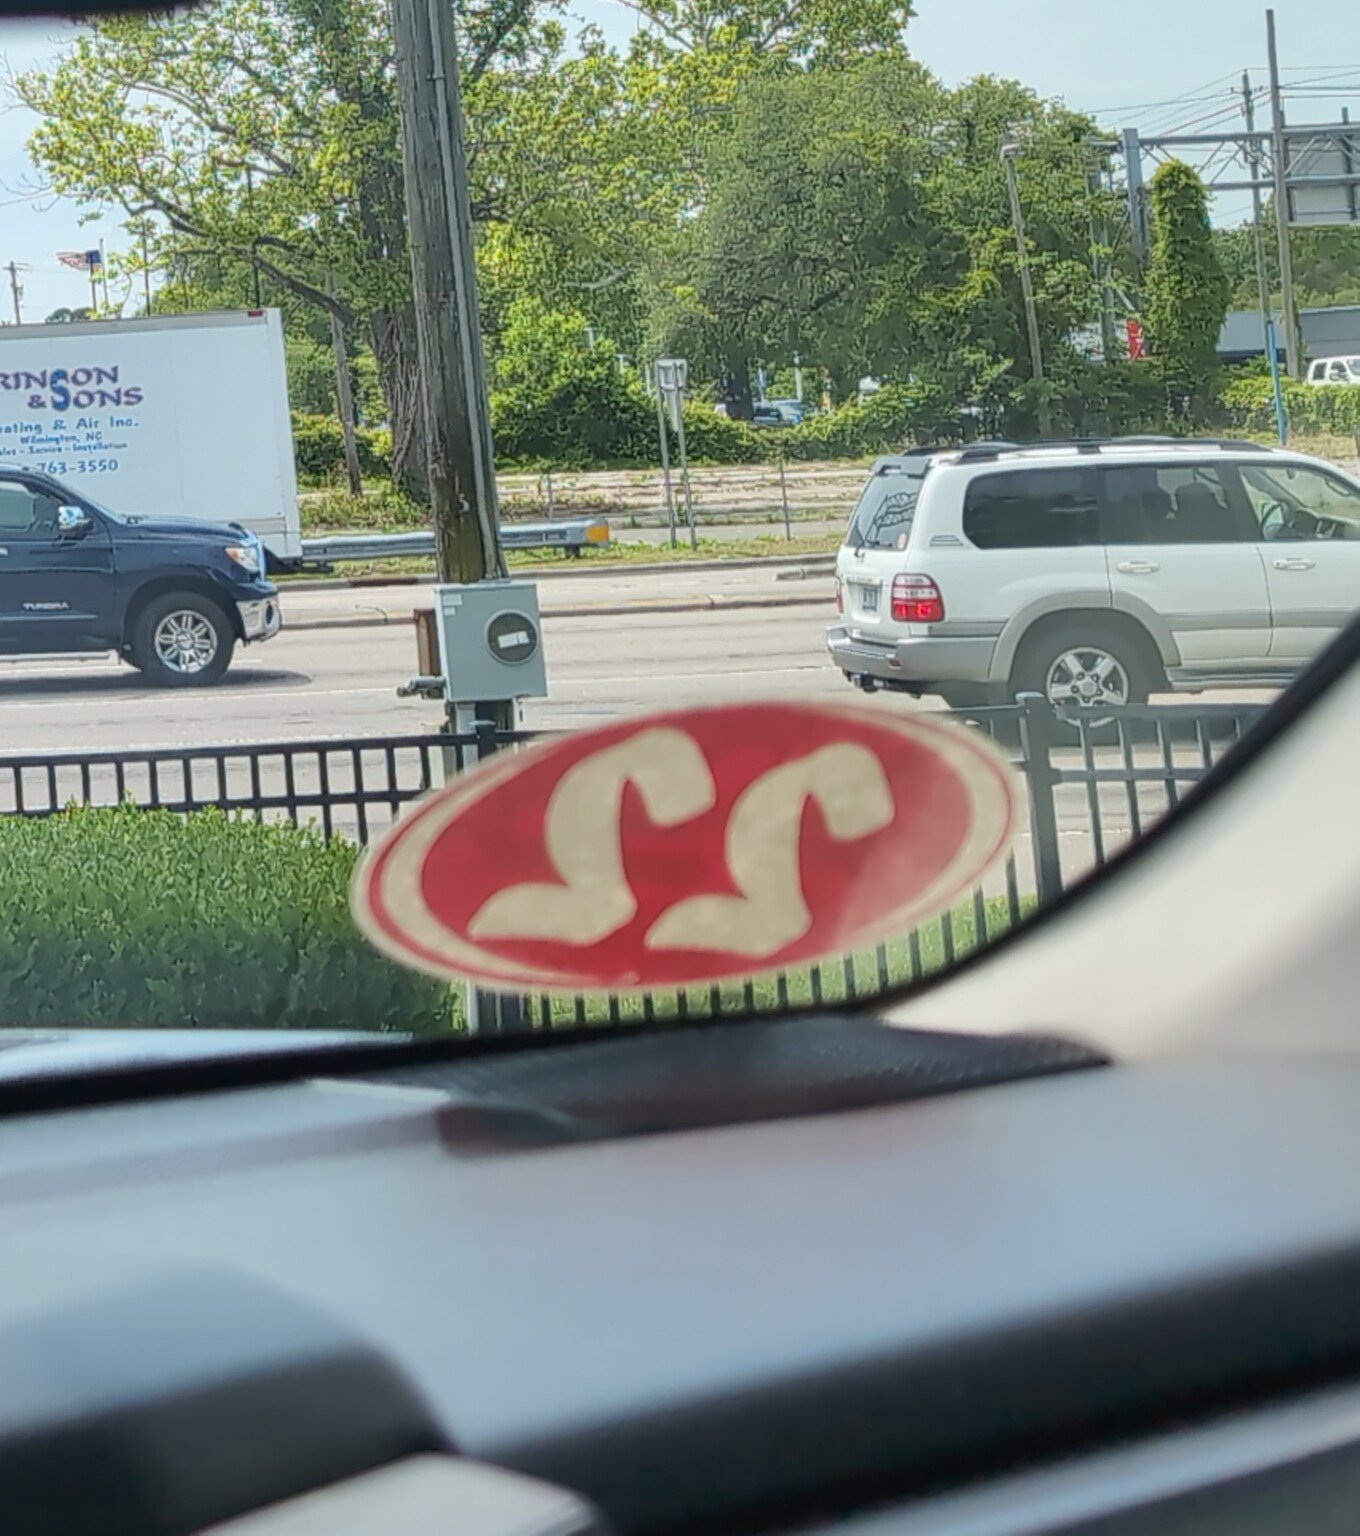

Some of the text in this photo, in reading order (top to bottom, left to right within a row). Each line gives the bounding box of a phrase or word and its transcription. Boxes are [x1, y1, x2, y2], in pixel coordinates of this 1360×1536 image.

[27, 381, 144, 412] & SONS
[54, 419, 67, 430] &
[76, 417, 100, 429] Air
[86, 431, 103, 441] NC
